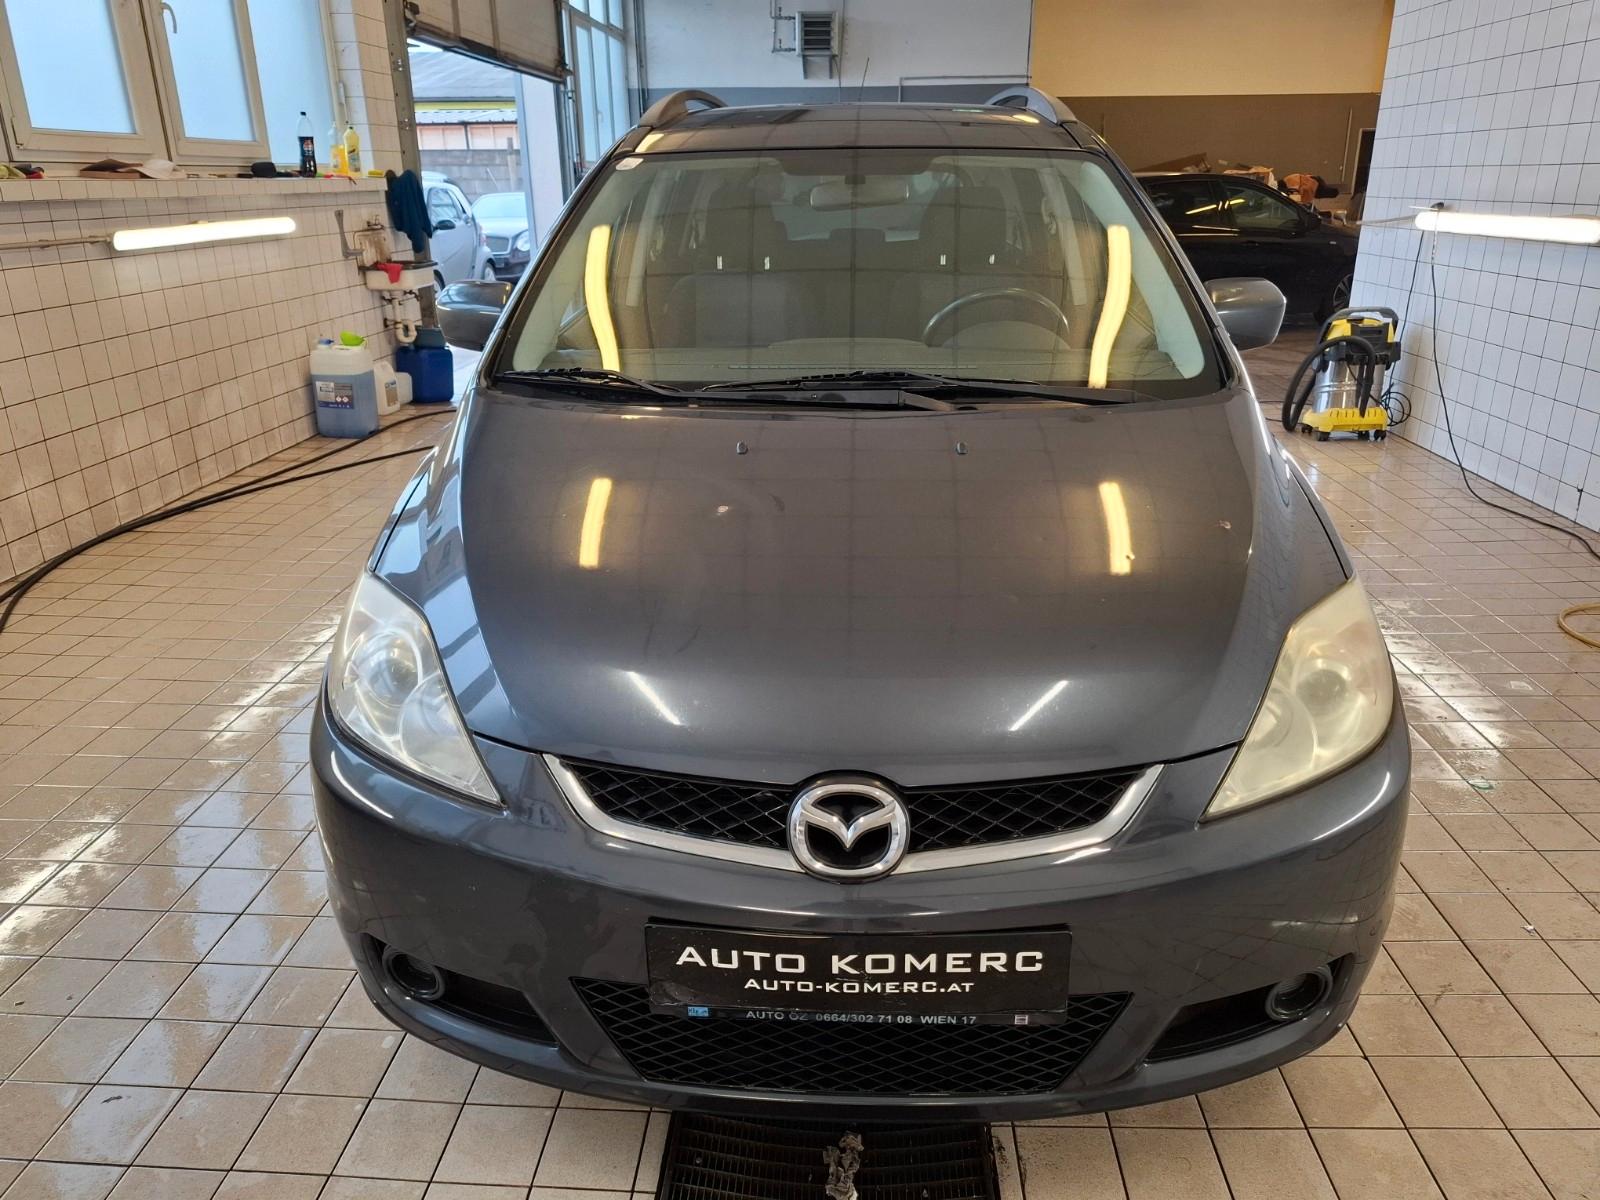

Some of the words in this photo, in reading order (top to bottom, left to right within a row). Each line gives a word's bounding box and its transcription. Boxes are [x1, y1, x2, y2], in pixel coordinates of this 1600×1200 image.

[676, 946, 805, 973] AUTO
[831, 951, 1043, 974] KOMERC
[744, 978, 975, 993] AUTO-KOMERC.AT
[745, 1010, 784, 1020] AUTO
[815, 1012, 873, 1023] 0664/302
[878, 1014, 892, 1023] 71
[897, 1014, 913, 1024] 08
[920, 1015, 957, 1024] WIEN
[961, 1015, 977, 1025] 17
